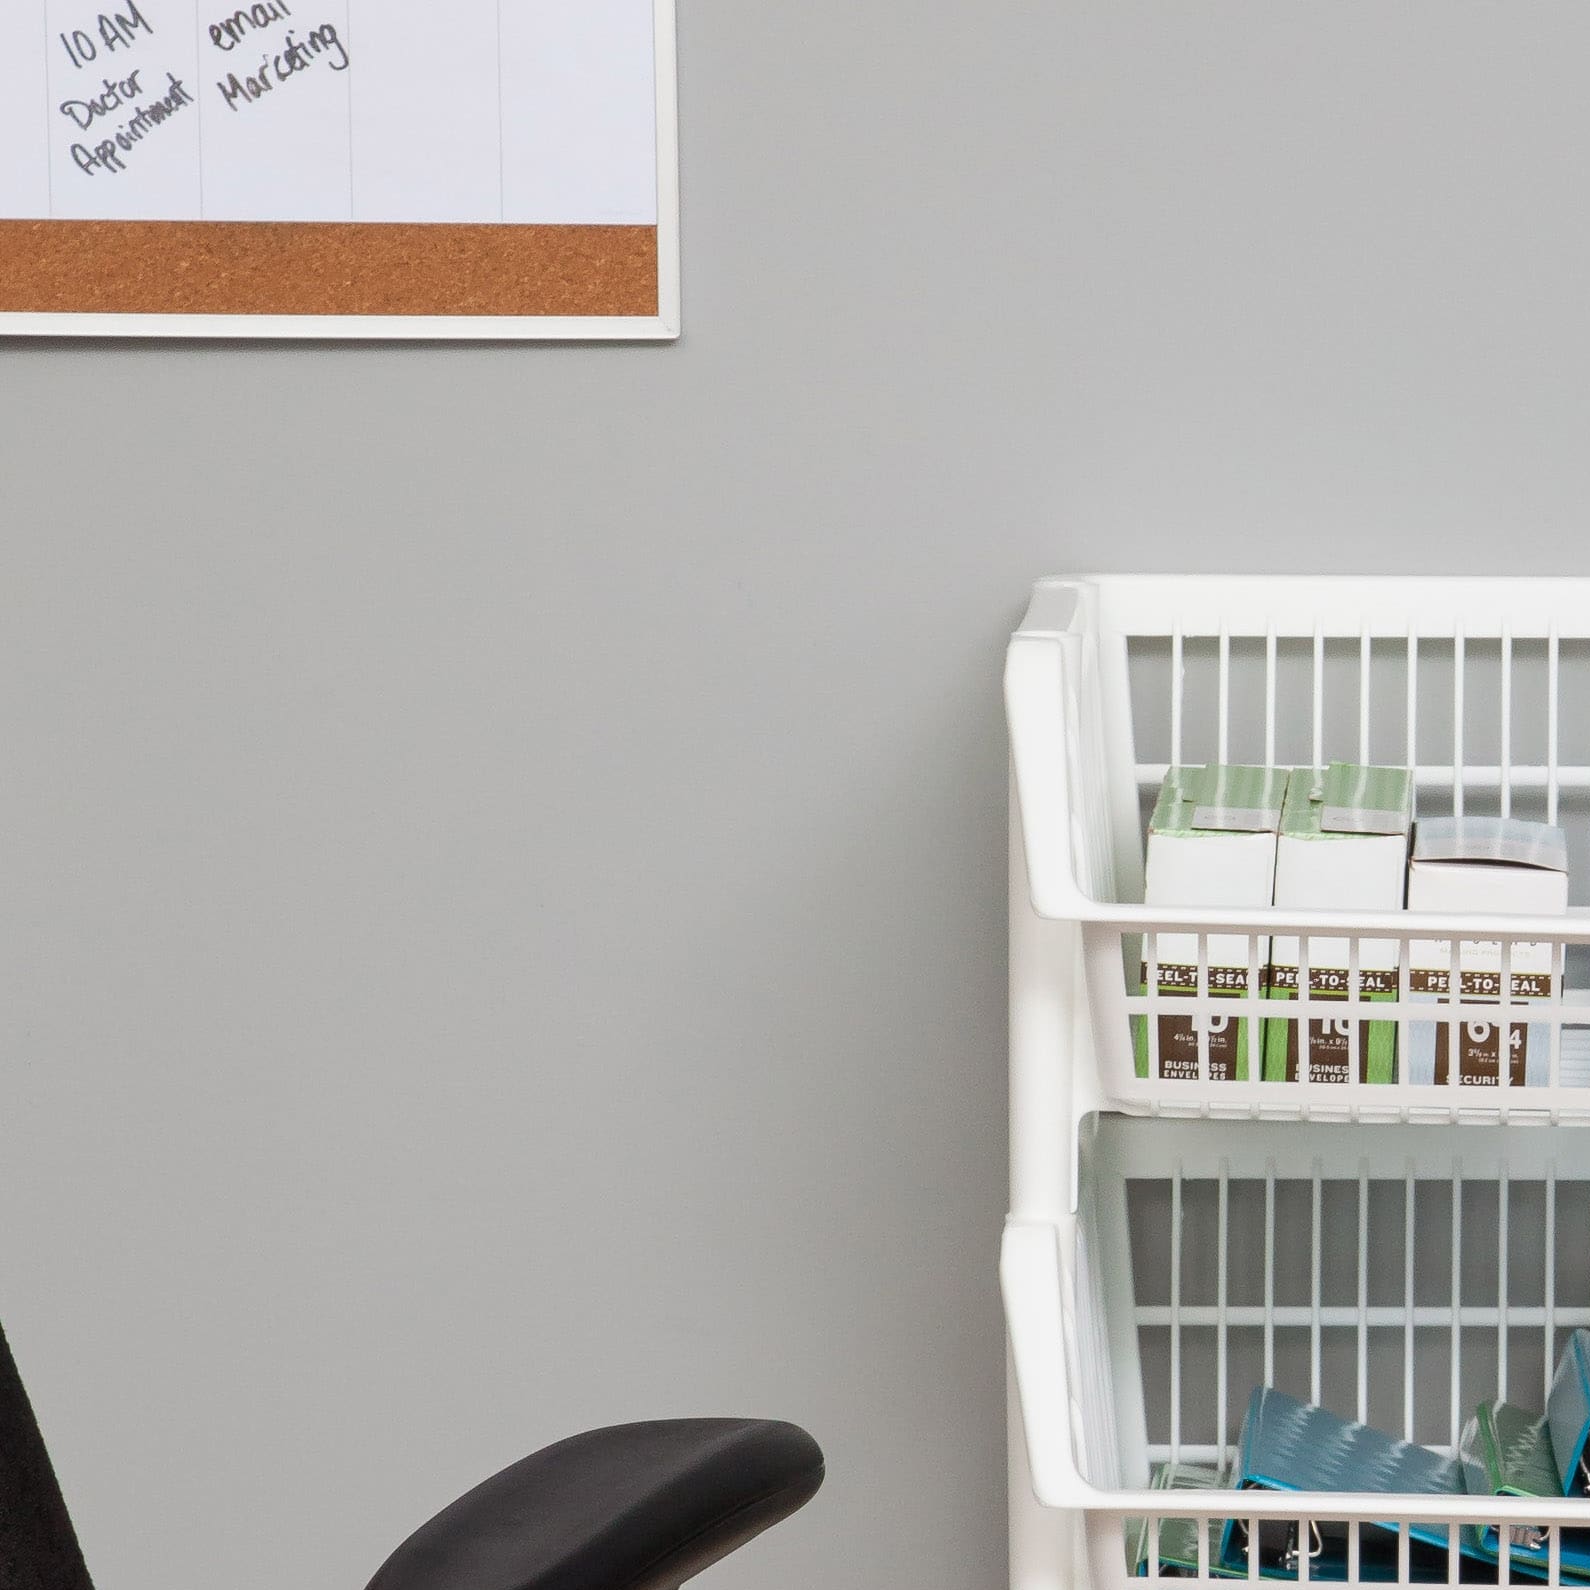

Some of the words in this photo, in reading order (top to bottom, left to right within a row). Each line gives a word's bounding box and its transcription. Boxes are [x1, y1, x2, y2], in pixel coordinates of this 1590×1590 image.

[60, 30, 96, 68] 10
[98, 0, 154, 51] AM
[60, 69, 143, 130] Doctor
[70, 72, 194, 176] Appointment
